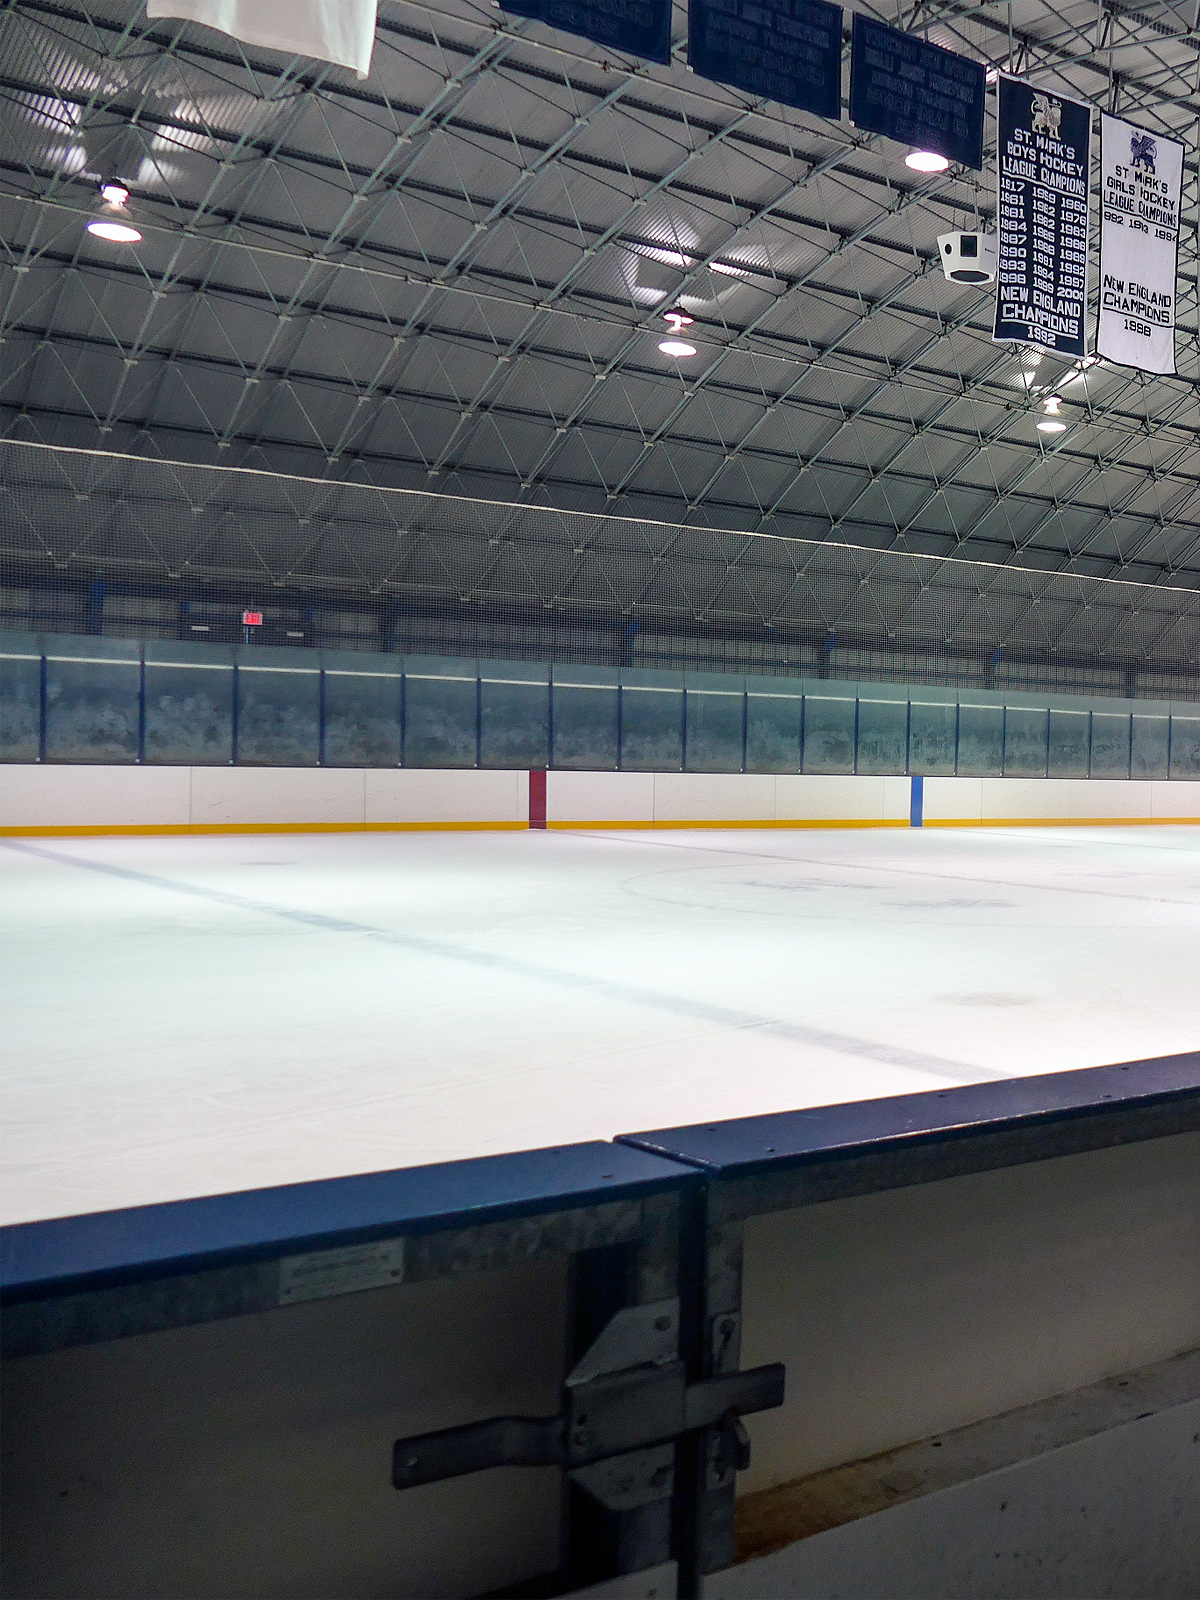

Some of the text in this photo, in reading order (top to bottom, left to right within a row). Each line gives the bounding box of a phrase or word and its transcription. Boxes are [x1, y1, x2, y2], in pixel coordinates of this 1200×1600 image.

[1007, 141, 1084, 177] BOYS HOCKEY
[1014, 128, 1076, 160] ST. MARK'S
[1002, 155, 1086, 196] LEAGUE CHAMPIONS
[1115, 165, 1129, 178] ST
[1001, 177, 1026, 192] 1917
[1060, 197, 1087, 213] 1960
[1001, 191, 1025, 206] 1961
[1060, 210, 1086, 226] 1976
[1103, 189, 1135, 212] LEAGUE
[1106, 176, 1176, 210] GIRLS HOCKEY
[1001, 204, 1025, 219] 1981
[1060, 223, 1086, 239] 1983
[1001, 218, 1027, 232] 1984
[1001, 231, 1027, 245] 1987
[1001, 244, 1027, 258] 1990
[1059, 261, 1085, 277] 1992
[1056, 286, 1084, 302] 2000
[1058, 274, 1084, 289] 1997
[1103, 274, 1172, 308] NEW ENGLAND
[1000, 285, 1081, 318] NEW ENGLAND
[1103, 291, 1170, 324] CHAMPIONS
[1002, 303, 1079, 335] CHAMPIONS
[1027, 325, 1056, 346] 1992
